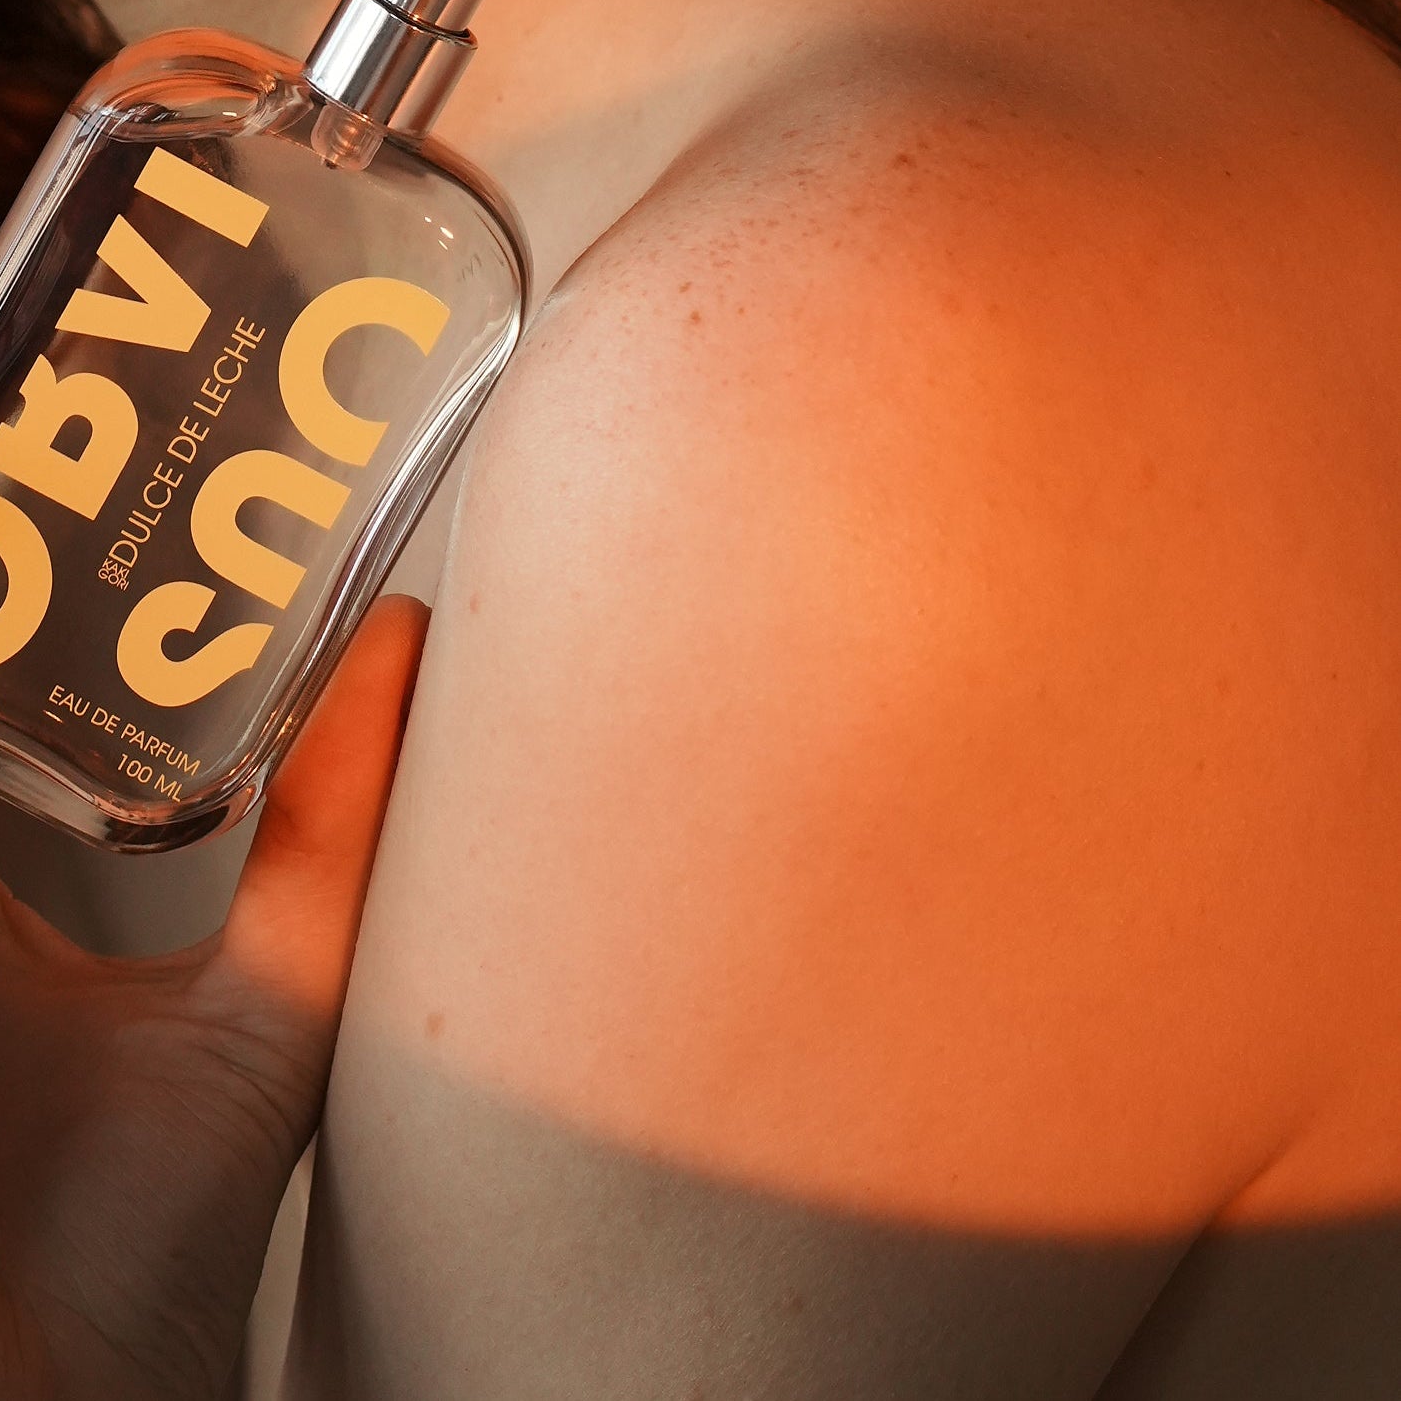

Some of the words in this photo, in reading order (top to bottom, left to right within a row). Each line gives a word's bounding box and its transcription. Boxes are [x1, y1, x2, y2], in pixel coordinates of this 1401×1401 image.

[108, 462, 184, 568] DULCE
[166, 415, 210, 465] DE
[192, 316, 267, 418] LECHE
[97, 568, 130, 592] GORI
[101, 557, 130, 579] KAKI
[48, 684, 91, 717] EAU
[90, 706, 121, 734] DE
[120, 723, 201, 777] PARFUM
[117, 753, 154, 784] 100
[153, 773, 183, 803] ML
